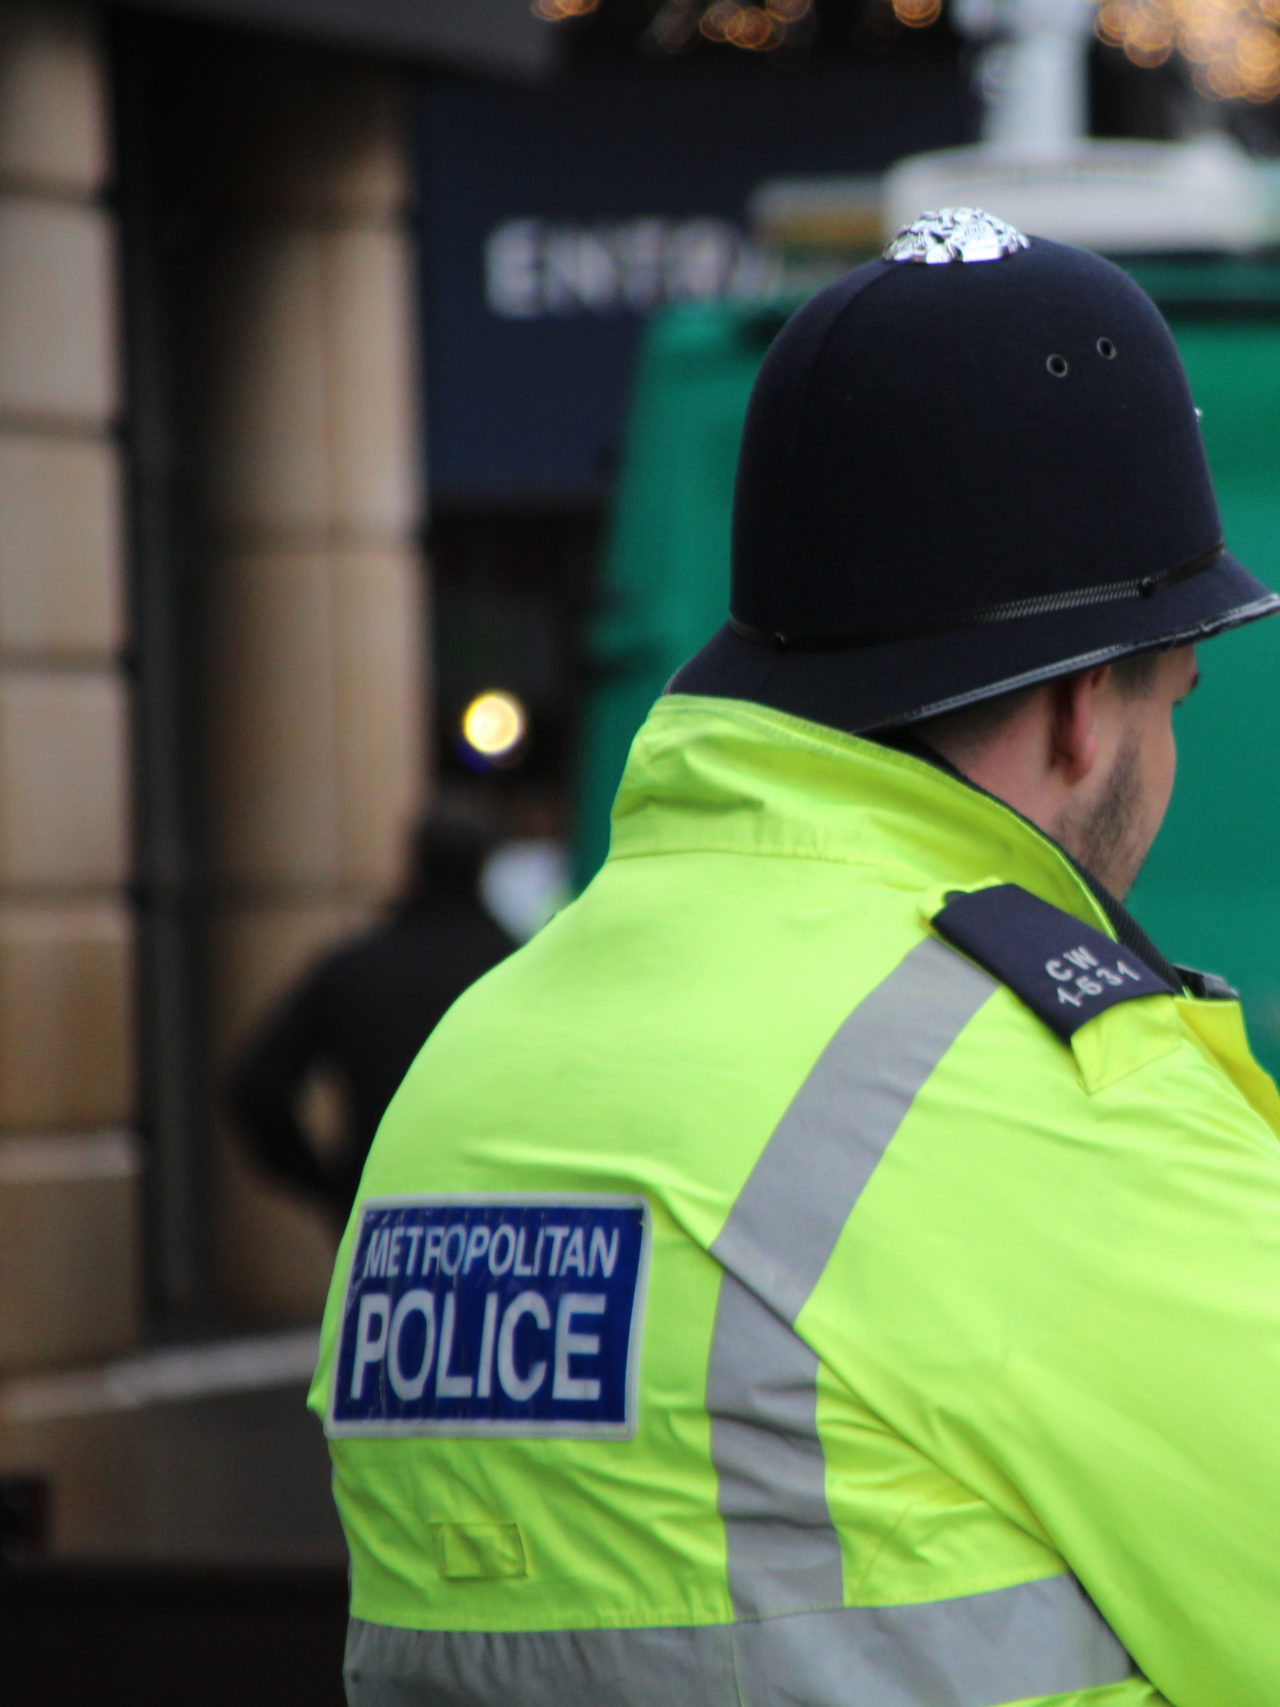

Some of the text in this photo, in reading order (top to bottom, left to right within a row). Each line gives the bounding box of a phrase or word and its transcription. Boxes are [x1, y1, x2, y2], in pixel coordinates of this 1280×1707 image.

[1044, 945, 1099, 982] CW
[365, 1223, 620, 1279] METROPOLITAN
[350, 1289, 606, 1401] POLICE
